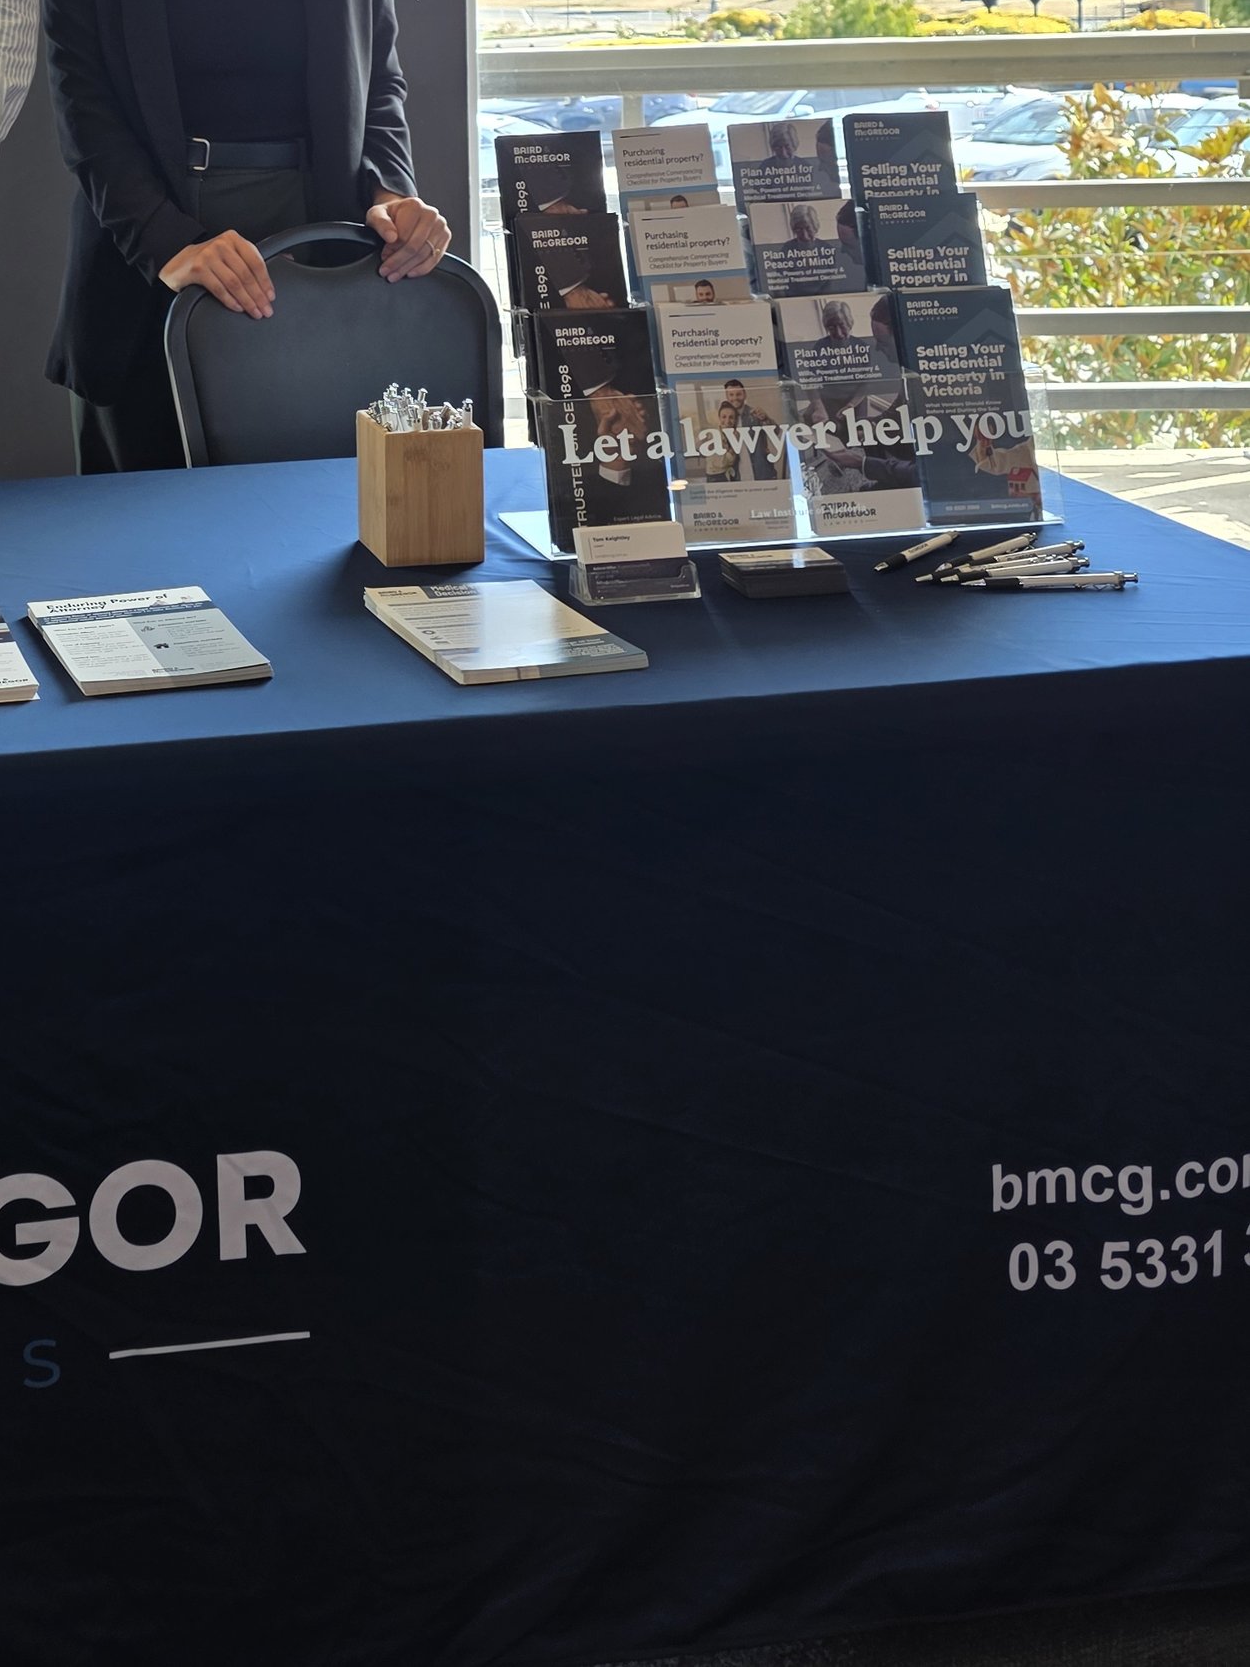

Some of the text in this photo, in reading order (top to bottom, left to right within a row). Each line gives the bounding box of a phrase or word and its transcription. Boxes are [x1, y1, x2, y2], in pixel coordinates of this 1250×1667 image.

[514, 146, 542, 154] BAIRD
[623, 148, 665, 157] Purchasing
[515, 154, 570, 163] McGREGOR
[624, 153, 704, 166] residential property?
[741, 165, 813, 177] Plan Ahead for
[861, 163, 942, 175] Selling Your
[742, 174, 811, 186] Peace of Mind
[863, 175, 938, 187] Residential
[516, 181, 528, 213] 1898
[532, 230, 560, 239] BAIRD
[645, 231, 689, 240] Purchasing
[533, 236, 588, 248] McGREGOR
[646, 237, 730, 250] residential property?
[763, 247, 836, 259] Plan Ahead for
[887, 246, 969, 259] Selling Your
[764, 256, 834, 269] Peace of Mind
[889, 258, 966, 272] Residential
[535, 266, 548, 299] 1898
[891, 270, 968, 286] Property in
[908, 307, 958, 316] McGREGOR
[555, 328, 585, 337] BAIRD
[672, 328, 720, 337] Purchasing
[557, 335, 615, 346] McGREGOR
[673, 336, 763, 347] residential property?
[674, 353, 719, 361] Comprehensive
[794, 344, 870, 358] Plan Ahead for
[917, 344, 1005, 357] Selling Your
[796, 354, 869, 368] Peace of Mind
[919, 356, 1002, 370] Residential
[558, 365, 572, 398] 1898
[921, 369, 1005, 384] Property in
[923, 383, 982, 397] Victoria
[558, 424, 637, 465] Let
[646, 430, 675, 460] a
[679, 416, 837, 463] lawyer
[843, 405, 943, 455] help
[950, 410, 1034, 452] you
[47, 601, 107, 610] Enduring
[110, 596, 151, 604] Power
[1009, 1240, 1077, 1291] 03
[1100, 1229, 1222, 1290] 5331
